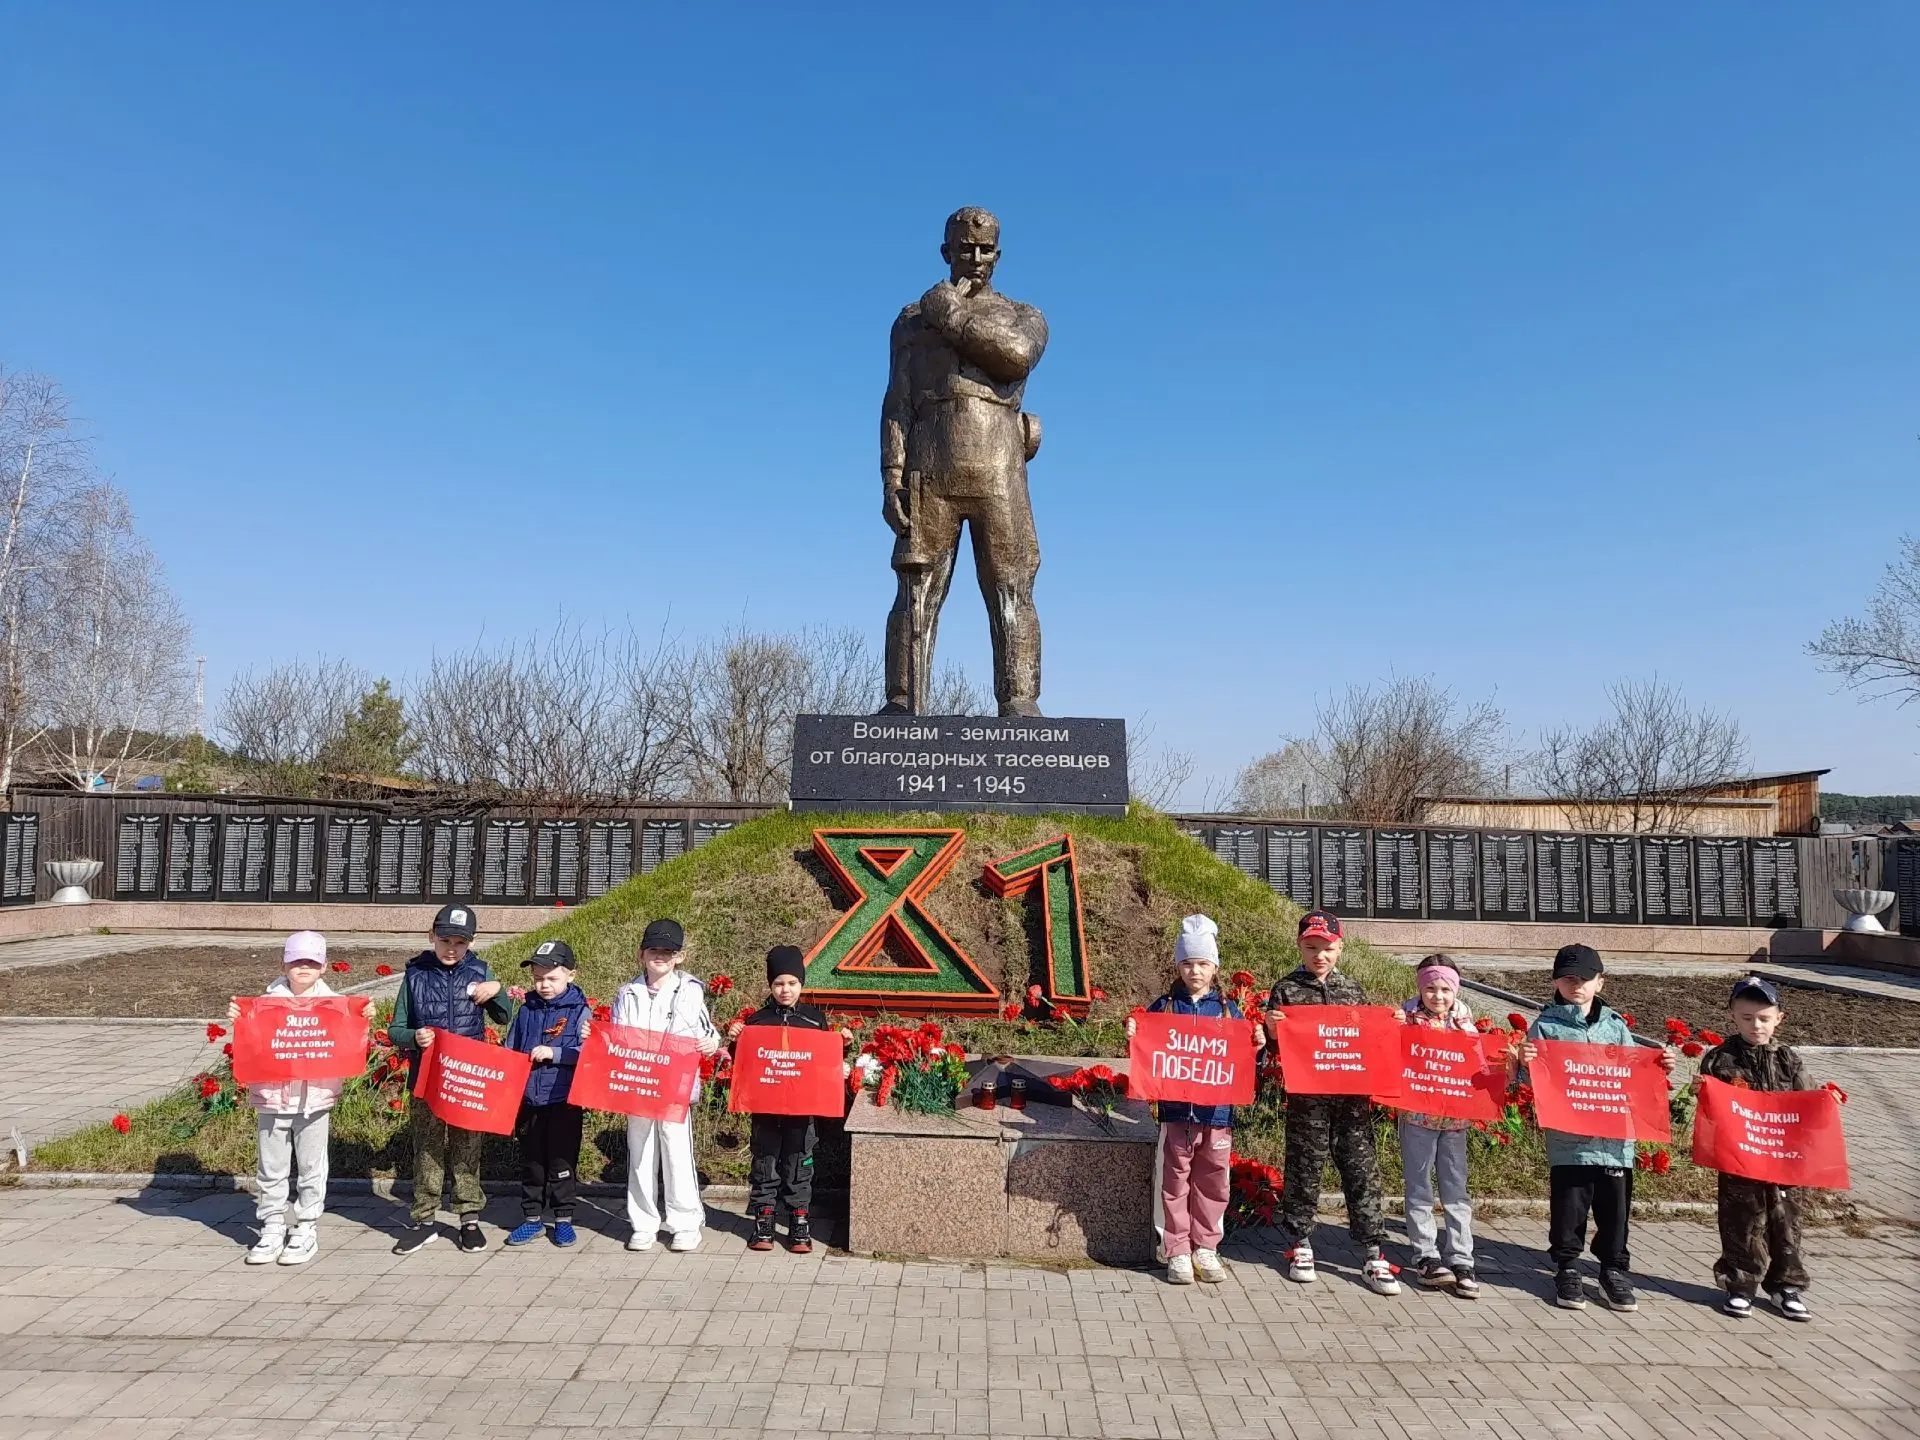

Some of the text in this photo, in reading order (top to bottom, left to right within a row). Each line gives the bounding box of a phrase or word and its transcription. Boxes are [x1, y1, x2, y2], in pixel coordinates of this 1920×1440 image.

[852, 721, 939, 740] Воинам
[960, 727, 1069, 743] землякам
[810, 747, 1110, 770] от благодарных тасеевцев
[896, 774, 946, 793] 1941
[973, 776, 1026, 794] 1945
[1166, 1028, 1228, 1057] ЗНАМЯ
[1152, 1050, 1234, 1086] ПОБЕДЫ
